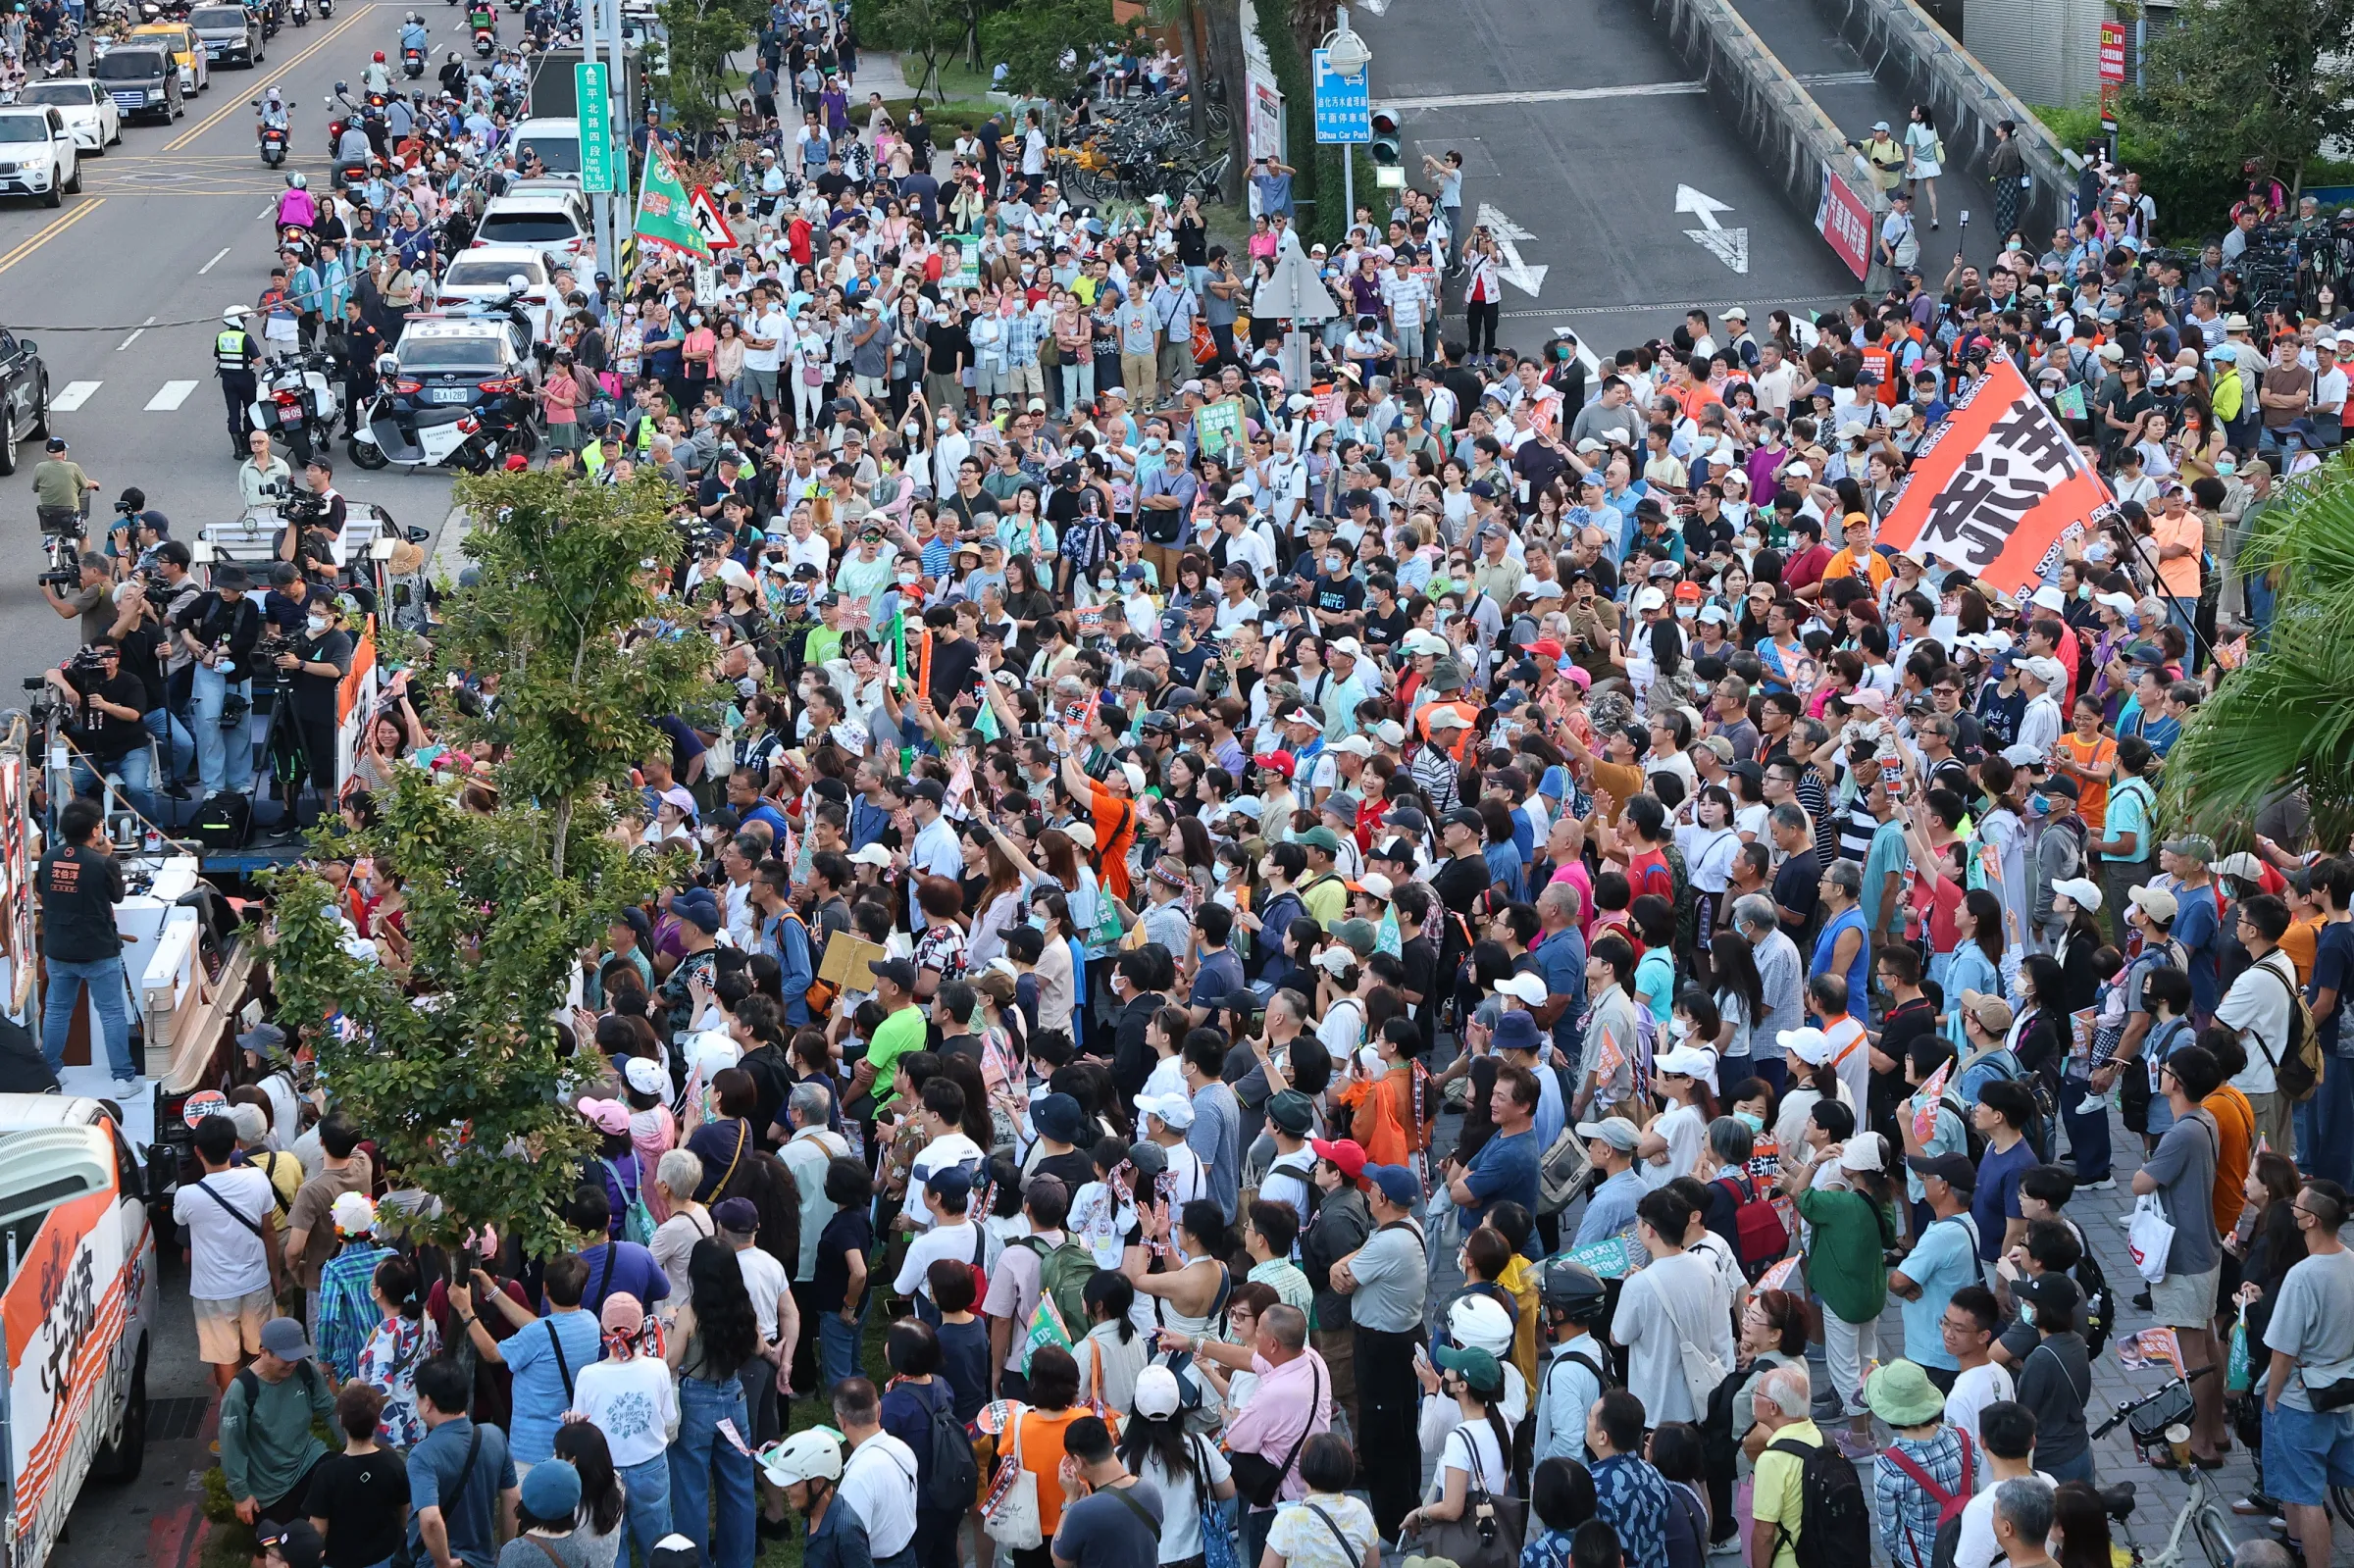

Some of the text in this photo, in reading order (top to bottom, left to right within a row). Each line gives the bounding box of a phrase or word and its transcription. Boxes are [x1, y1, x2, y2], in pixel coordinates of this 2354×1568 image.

[587, 75, 601, 157] 延平北路四段
[1318, 113, 1367, 124] 平面停車場
[1319, 130, 1368, 140] Dihua Car Park
[586, 165, 600, 174] Ping
[1827, 190, 1868, 263] 汽車專用道
[698, 262, 711, 301] 當心行人
[1203, 405, 1234, 419] 你的市長
[1203, 415, 1236, 431] 沈伯洋
[52, 868, 78, 881] 沈伯洋
